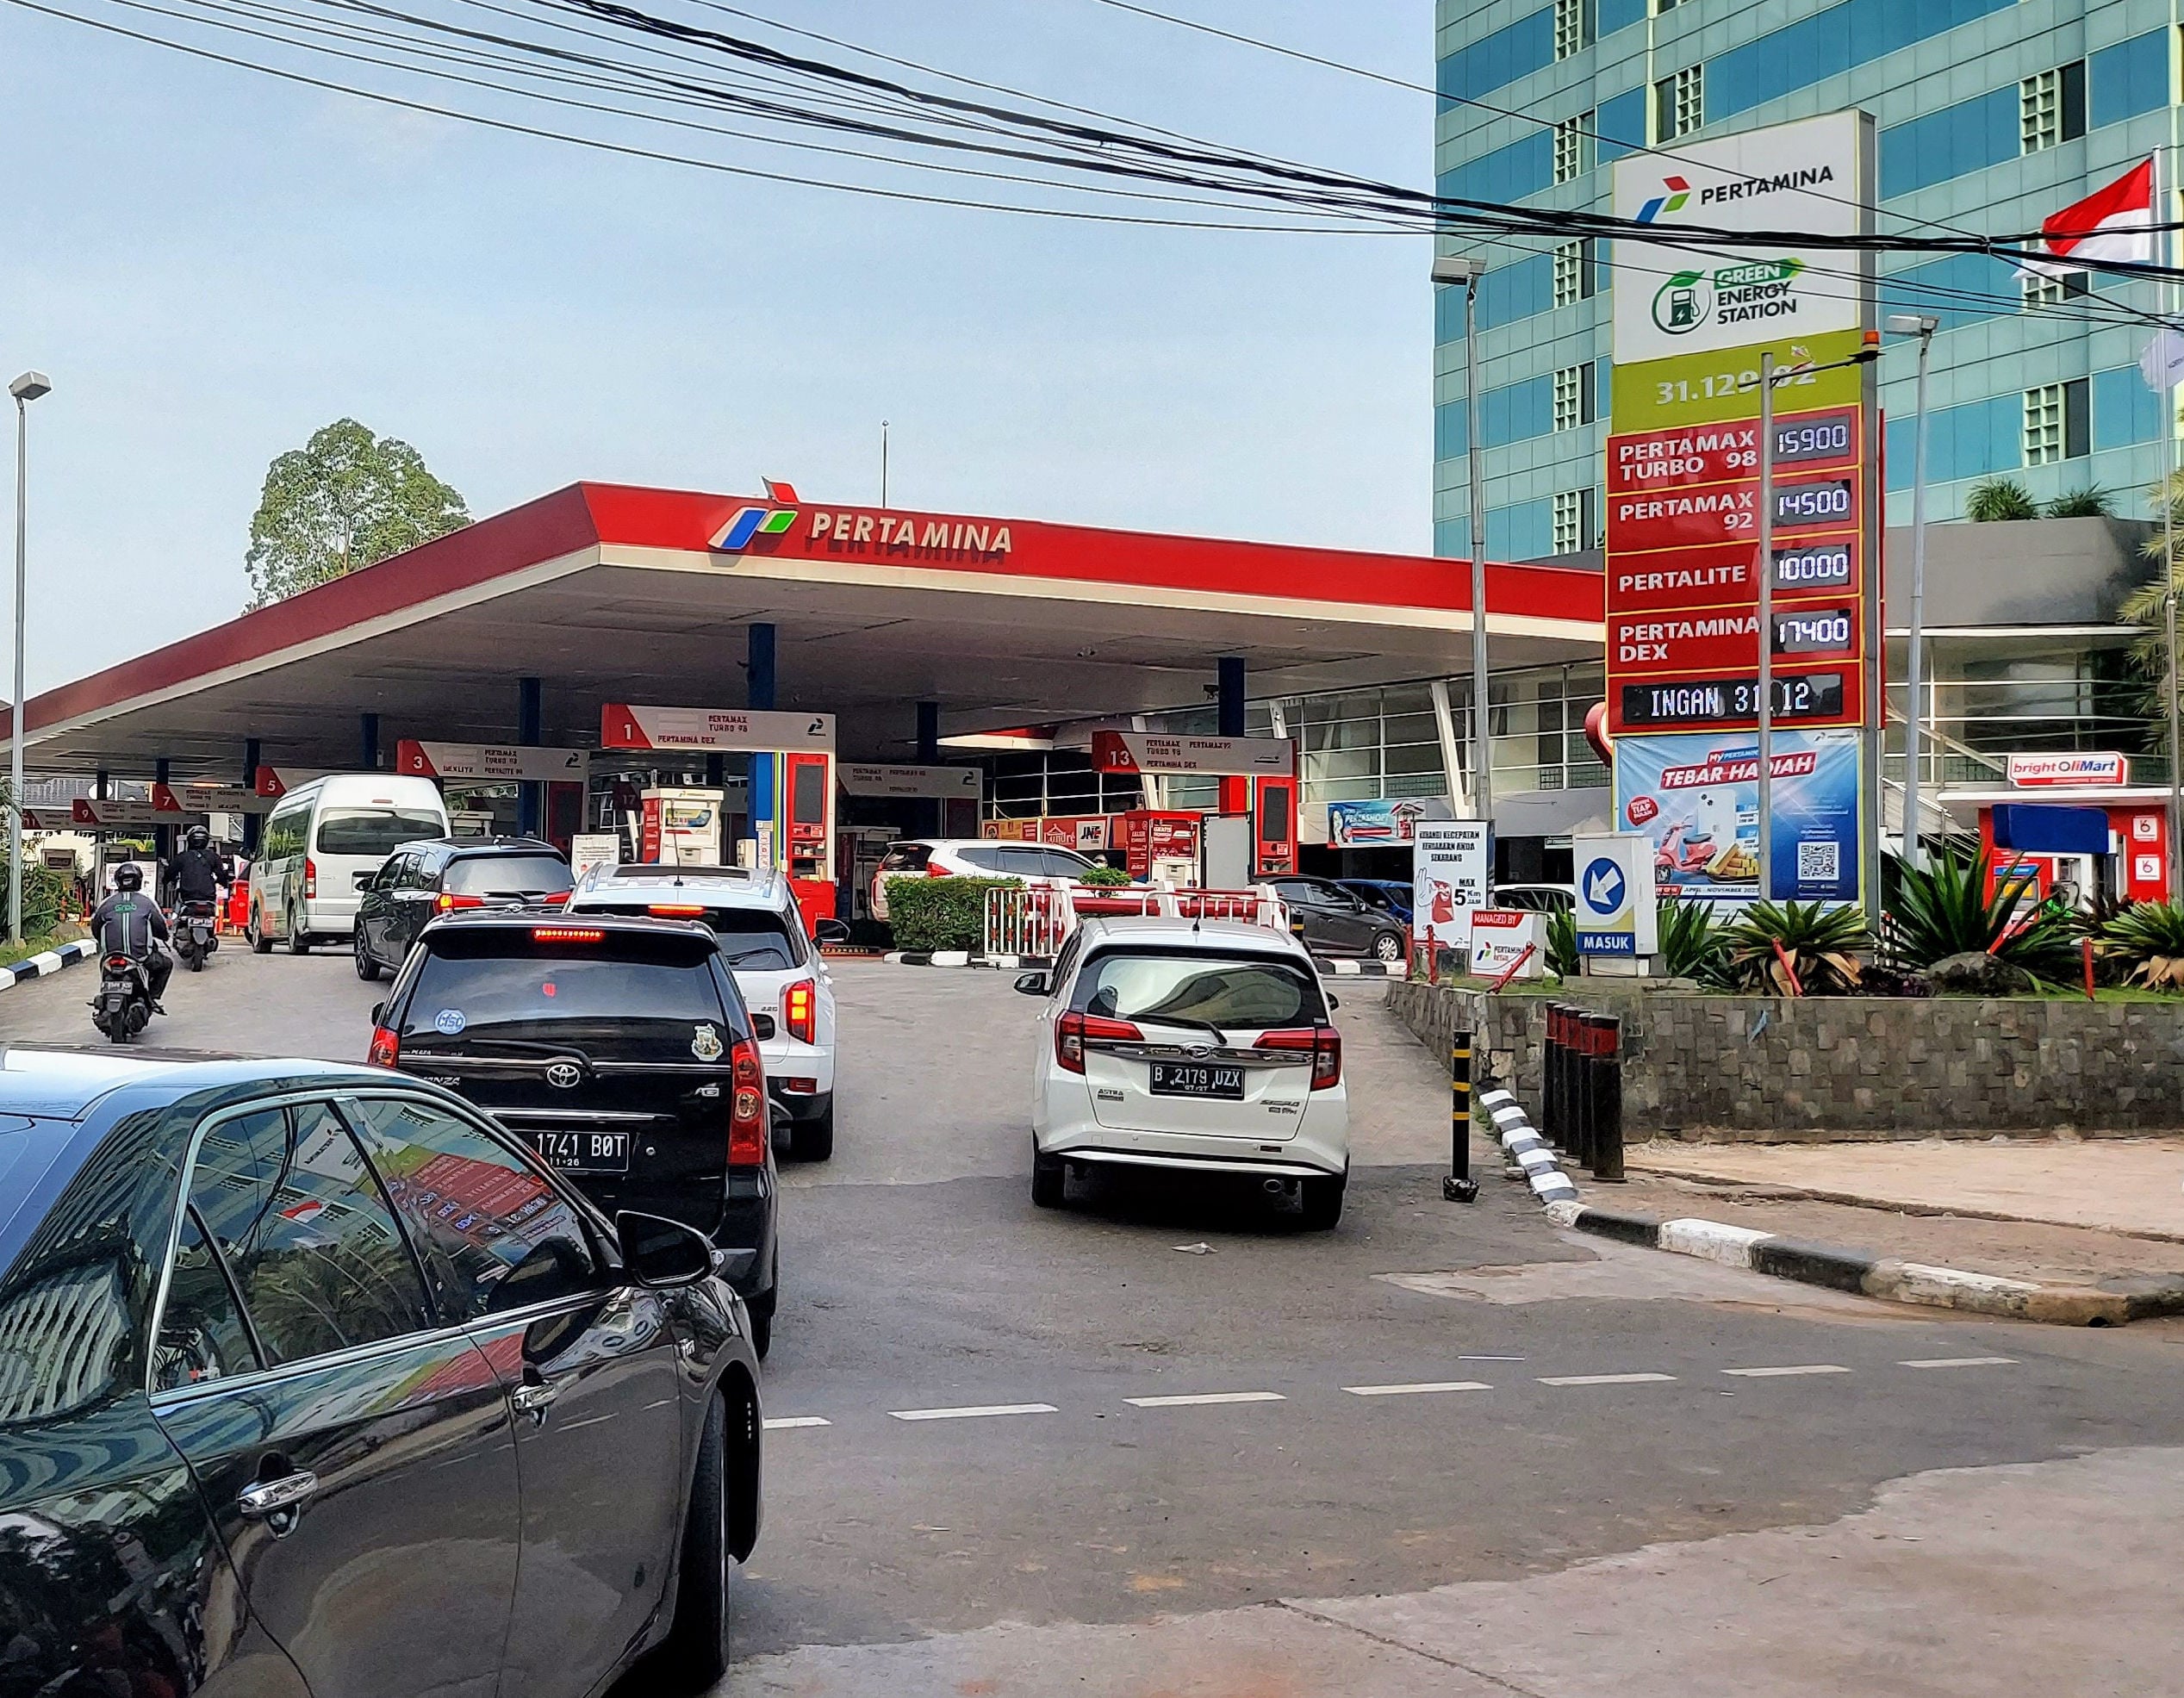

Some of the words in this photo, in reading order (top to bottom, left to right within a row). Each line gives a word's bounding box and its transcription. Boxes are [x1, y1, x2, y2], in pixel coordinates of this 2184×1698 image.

[1701, 166, 1833, 205] PERTAMINA
[1716, 264, 1781, 287] GREEN
[1717, 281, 1792, 307] ENERGY
[1717, 299, 1797, 325] STATION
[1620, 430, 1755, 462] PERTAMAX
[1778, 425, 1847, 454] 15900
[1620, 457, 1704, 481] TURBO
[1726, 451, 1758, 469] 98
[1620, 491, 1754, 521] PERTAMAX
[1778, 488, 1848, 517] 14500
[812, 512, 1011, 553] PERTAMINA
[1724, 513, 1753, 531] 92
[1779, 553, 1848, 582] 10000
[1619, 565, 1746, 593] PERTALITE
[1620, 615, 1760, 643] PERTAMINA
[1779, 618, 1848, 644] 17400
[1620, 644, 1668, 662] DEX
[1652, 687, 1720, 717] INGAN
[625, 725, 632, 740] 1
[658, 735, 699, 743] PERTAMINA
[414, 756, 423, 768] 3
[1110, 750, 1129, 766] 13
[2013, 762, 2056, 774] bright
[2058, 761, 2116, 772] OliMart
[267, 781, 277, 792] 5
[1664, 766, 1723, 787] TEBAR
[163, 796, 171, 806] 7
[623, 794, 636, 804] 17
[82, 810, 89, 818] 9
[1080, 825, 1102, 839] JNE
[1454, 889, 1465, 905] 5
[1474, 913, 1506, 924] MANAGED
[1508, 914, 1516, 924] BY
[1584, 935, 1629, 950] MASUK
[1154, 1067, 1163, 1081] B
[1174, 1068, 1207, 1084] 2179
[1215, 1070, 1240, 1086] UZX
[537, 1133, 578, 1155] 1741
